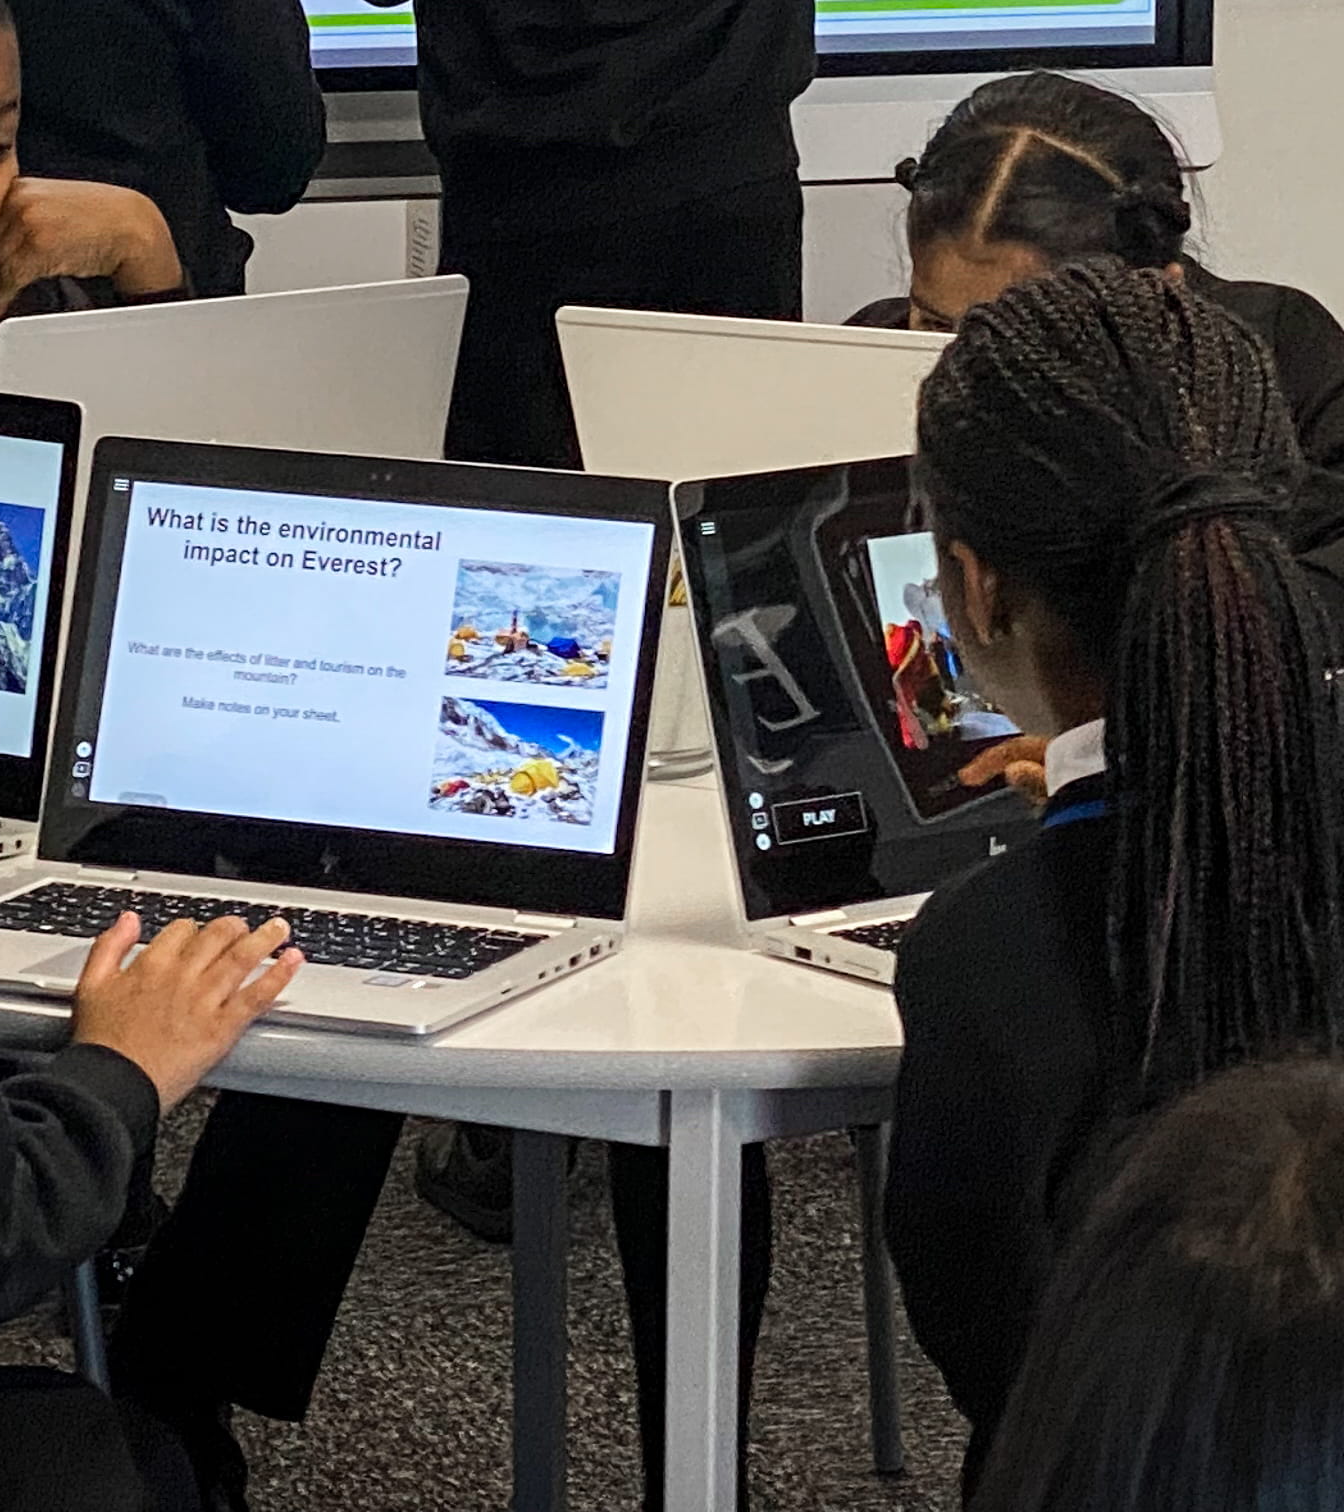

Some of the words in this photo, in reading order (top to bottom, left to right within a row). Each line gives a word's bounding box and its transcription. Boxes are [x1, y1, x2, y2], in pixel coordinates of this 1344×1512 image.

[147, 506, 204, 532] What
[210, 511, 229, 533] is
[237, 514, 272, 537] the
[278, 520, 442, 552] environmental
[183, 539, 260, 567] impact
[266, 550, 294, 569] on
[301, 549, 403, 578] Everest?
[127, 640, 159, 657] What
[162, 646, 182, 658] are
[184, 647, 204, 661] the
[206, 649, 246, 666] effects
[249, 653, 263, 666] of
[293, 657, 317, 672] and
[319, 659, 364, 675] tourism
[367, 664, 383, 677] on
[386, 665, 407, 679] the
[233, 668, 299, 686] mountain?
[182, 695, 215, 711] Make
[217, 699, 252, 715] notes
[254, 705, 270, 716] on
[272, 706, 299, 720] your
[801, 808, 836, 827] PLAY
